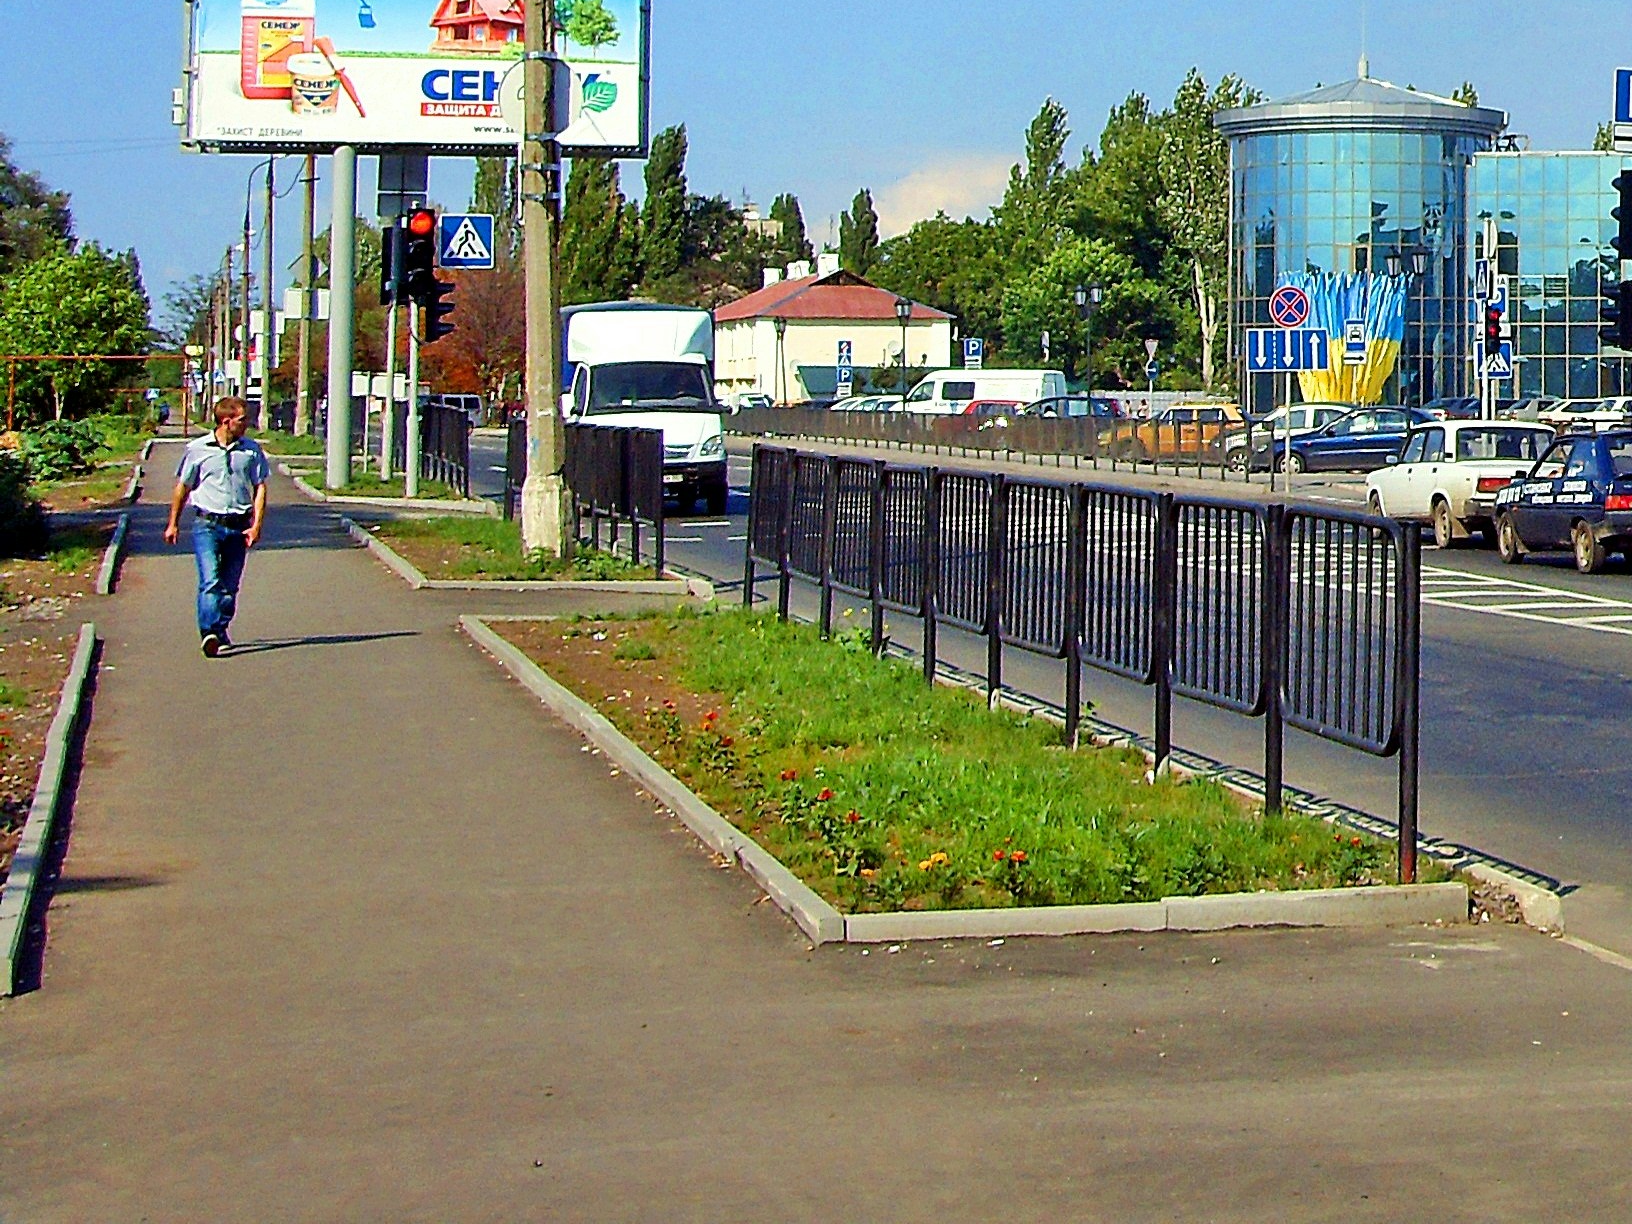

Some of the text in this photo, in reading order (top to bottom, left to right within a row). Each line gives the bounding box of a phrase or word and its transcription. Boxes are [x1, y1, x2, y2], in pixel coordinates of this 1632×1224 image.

[427, 103, 487, 117] ЗАЩИТА
[968, 340, 980, 355] P
[841, 368, 850, 382] P
